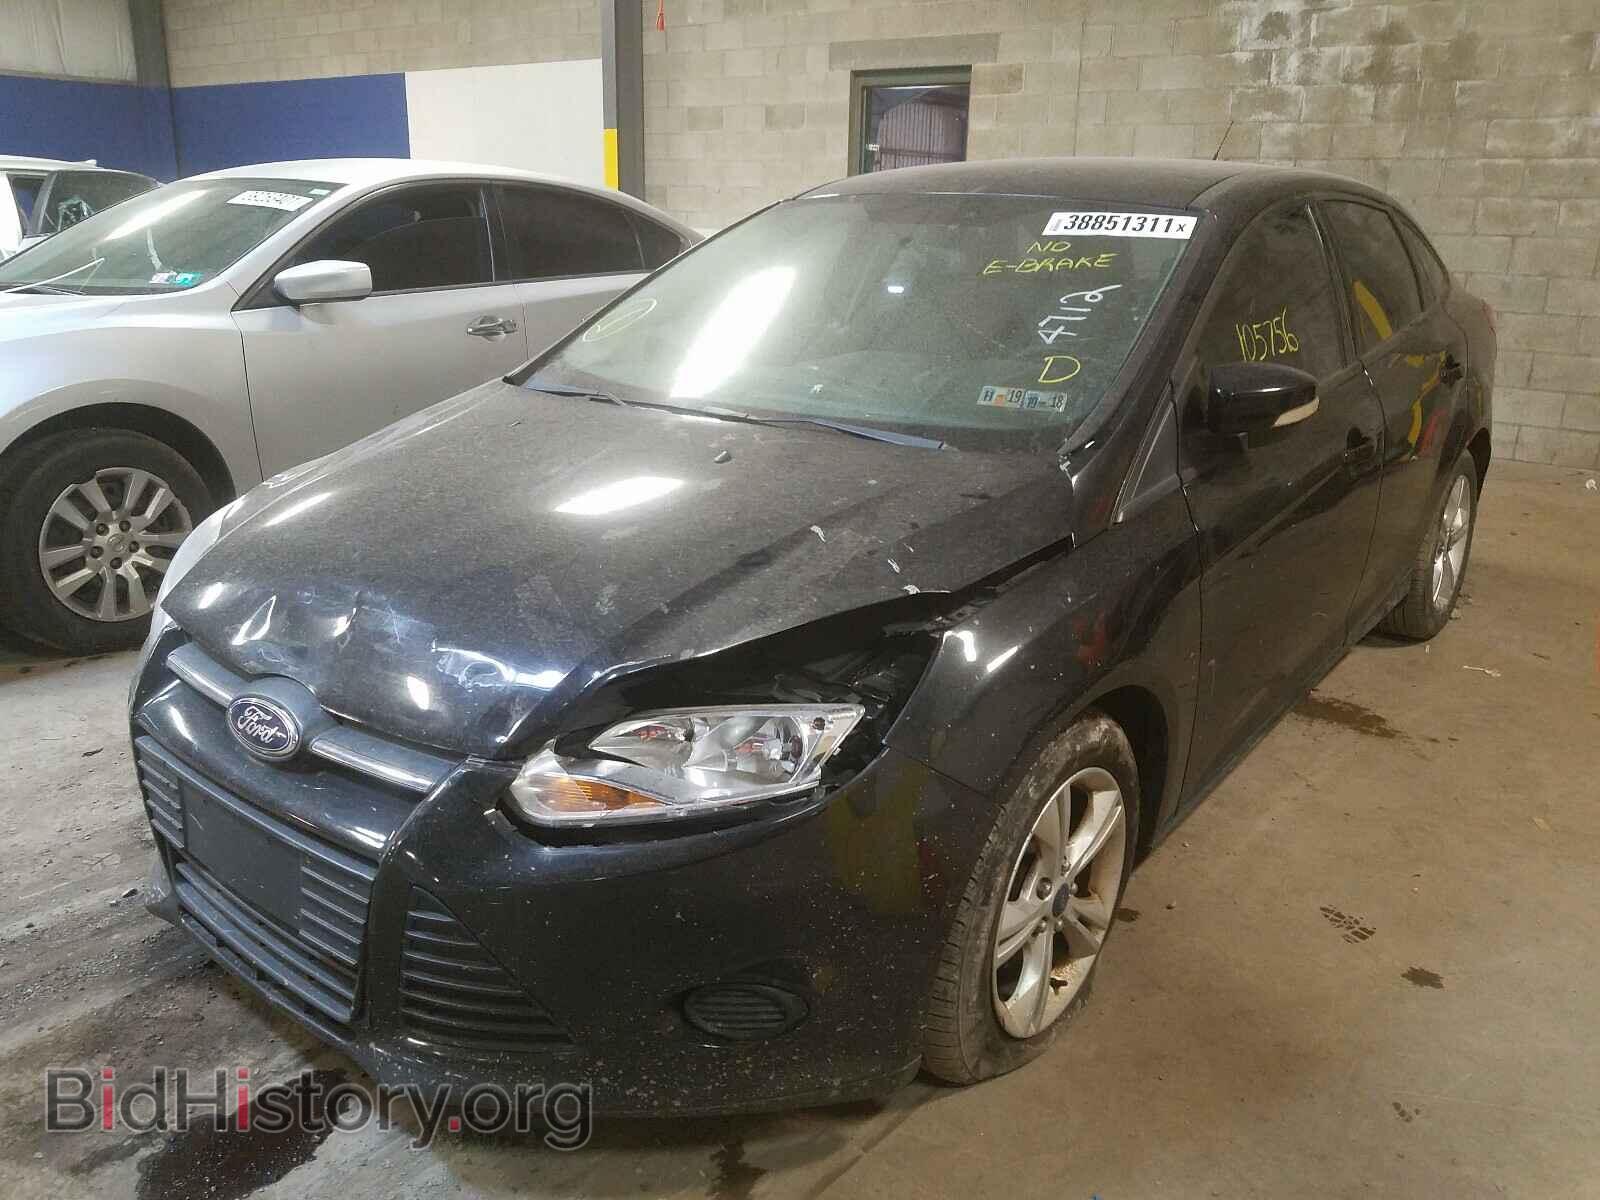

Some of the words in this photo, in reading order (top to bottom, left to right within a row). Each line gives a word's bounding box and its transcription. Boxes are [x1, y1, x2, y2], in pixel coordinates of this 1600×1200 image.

[1063, 214, 1174, 233] 38851311
[1026, 241, 1072, 254] NO
[982, 252, 1120, 275] E-BRAKE
[1235, 306, 1299, 363] 105756
[1037, 355, 1081, 384] D
[1008, 390, 1022, 404] 19
[237, 705, 287, 744] Ford
